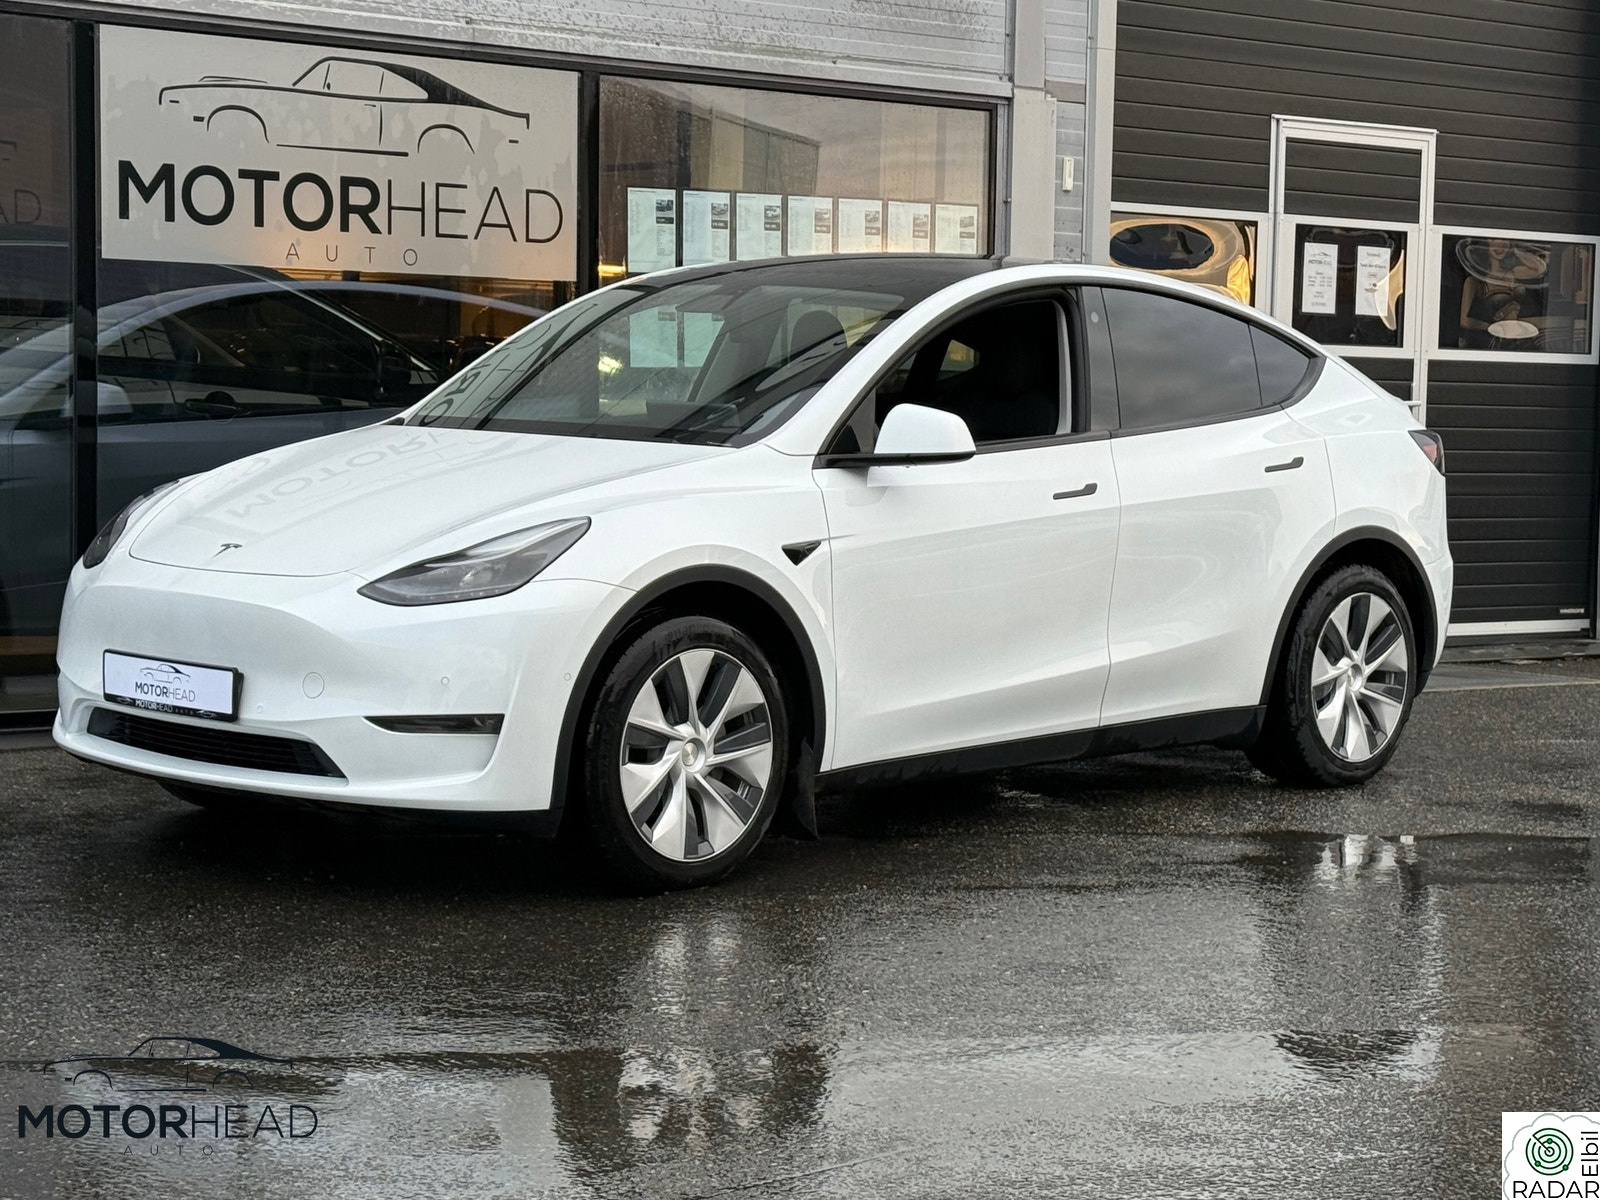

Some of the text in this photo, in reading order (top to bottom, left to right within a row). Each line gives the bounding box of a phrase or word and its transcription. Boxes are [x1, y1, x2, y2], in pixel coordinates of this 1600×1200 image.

[118, 160, 564, 243] MOTORHEAD
[286, 242, 418, 267] AUTO
[135, 681, 196, 702] MOTORHEAD
[135, 700, 173, 713] MOTORHEAD
